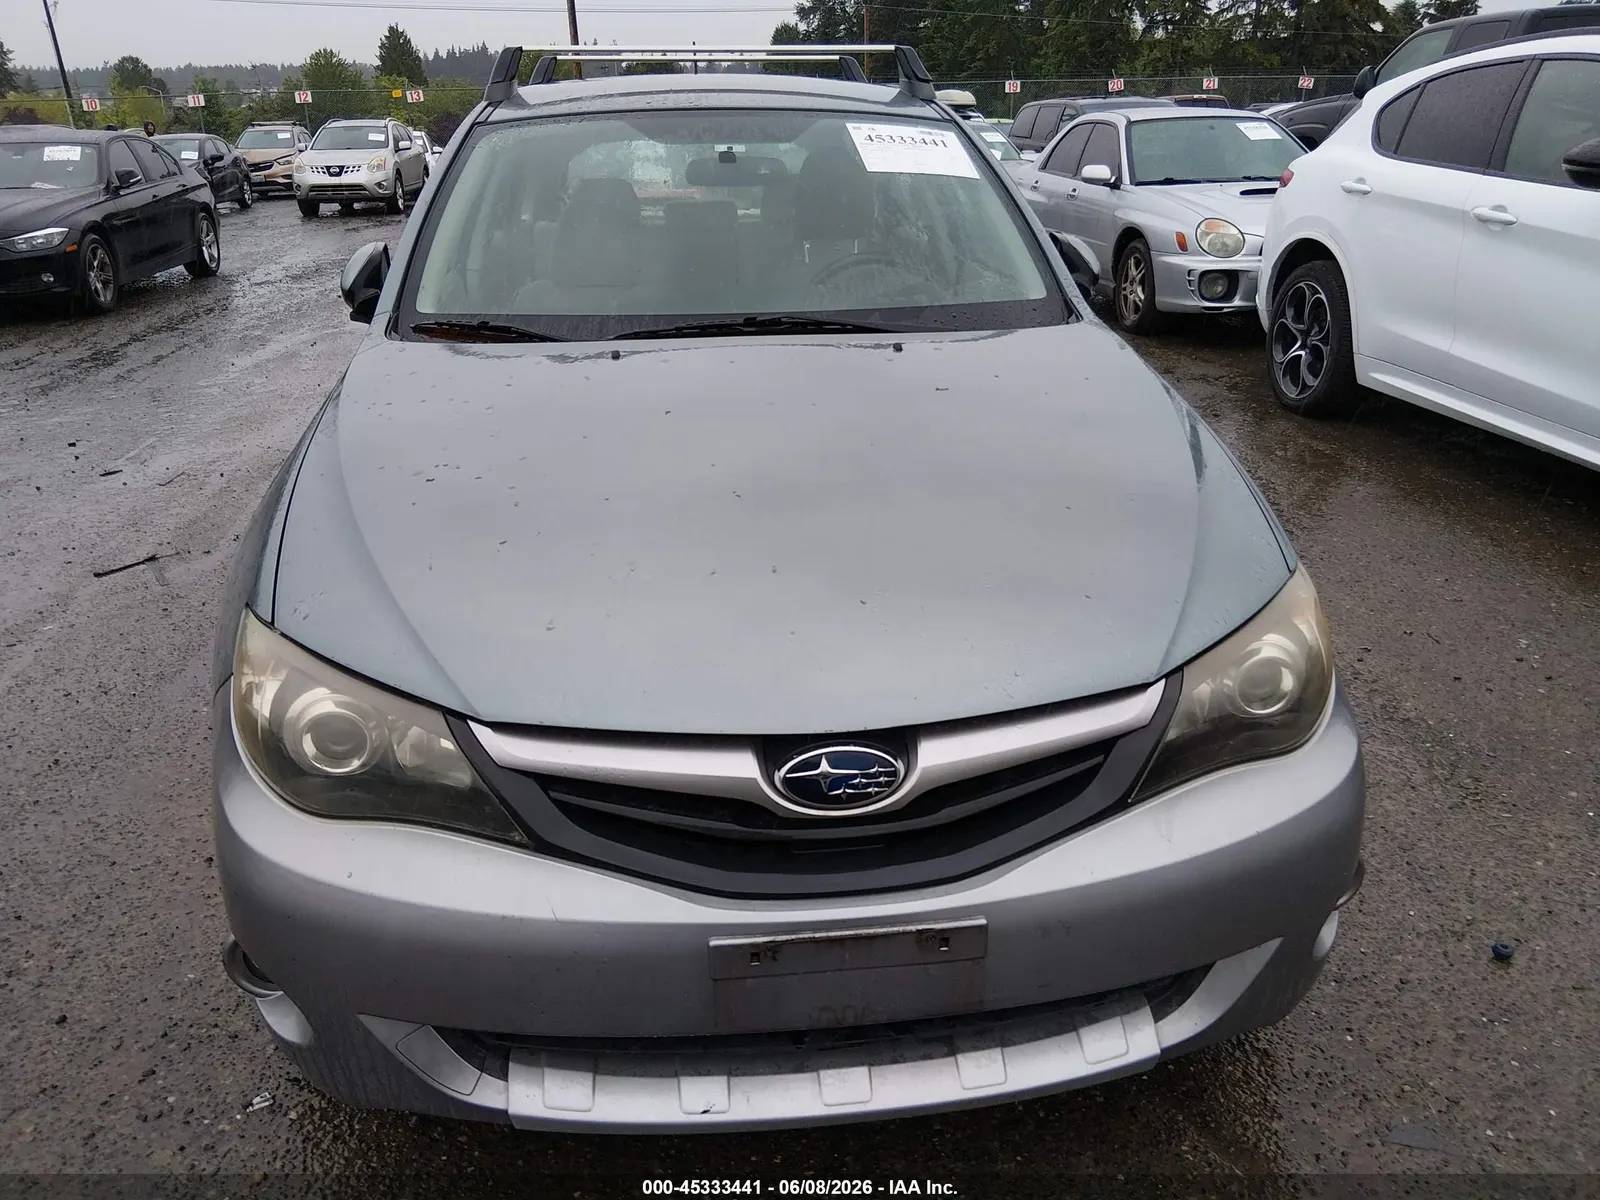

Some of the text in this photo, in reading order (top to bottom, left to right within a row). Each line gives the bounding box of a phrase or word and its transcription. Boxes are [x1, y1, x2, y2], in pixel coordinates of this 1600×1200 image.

[1007, 81, 1019, 92] 19
[1110, 79, 1123, 90] 20
[1205, 79, 1216, 89] 21
[1299, 77, 1313, 88] 22
[191, 95, 201, 106] 11
[297, 91, 310, 103] 12
[408, 90, 421, 102] 13
[84, 99, 98, 110] 10
[864, 133, 948, 149] 45333441
